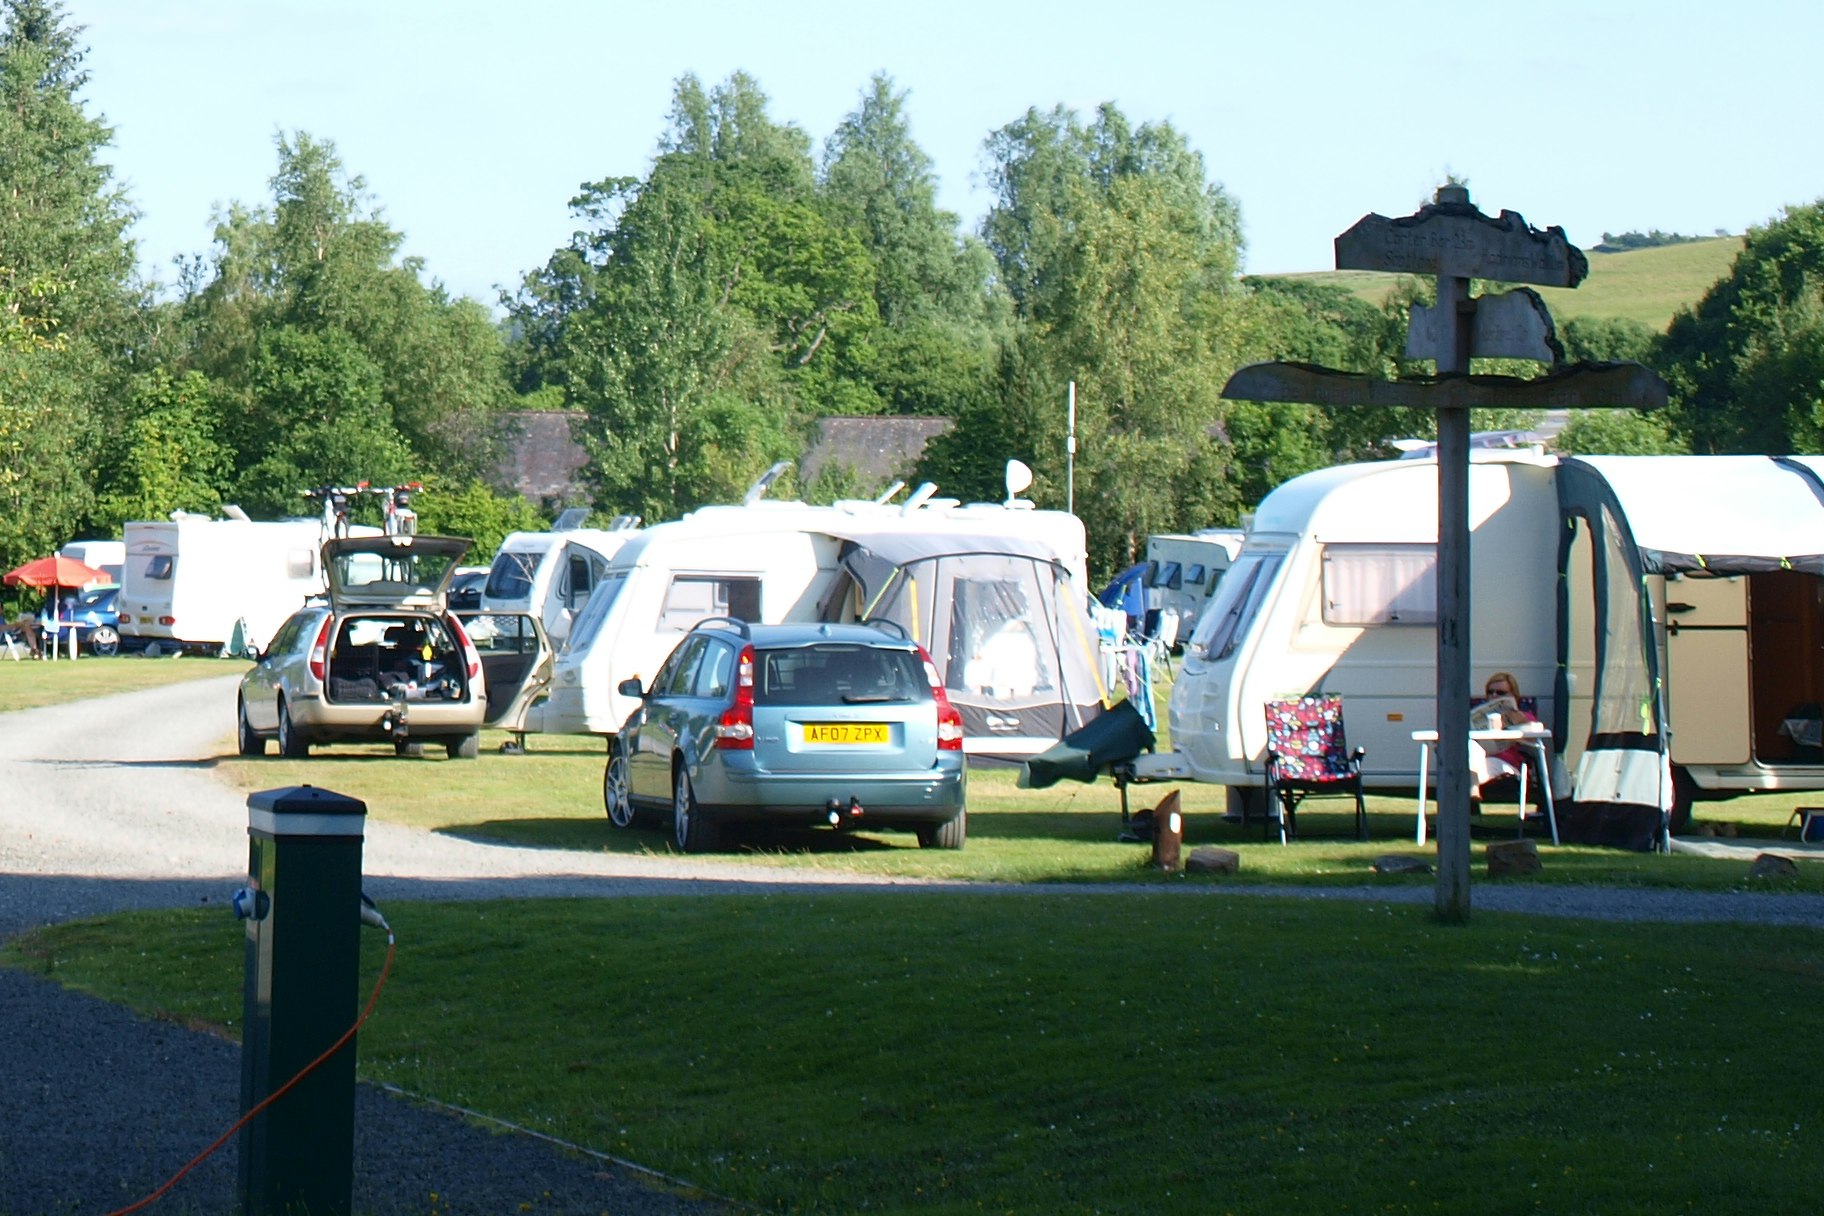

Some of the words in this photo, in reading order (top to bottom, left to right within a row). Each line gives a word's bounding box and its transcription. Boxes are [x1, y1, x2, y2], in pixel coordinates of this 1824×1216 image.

[1385, 227, 1426, 247] Carter
[811, 727, 848, 741] AF07
[855, 727, 882, 741] ZPX
